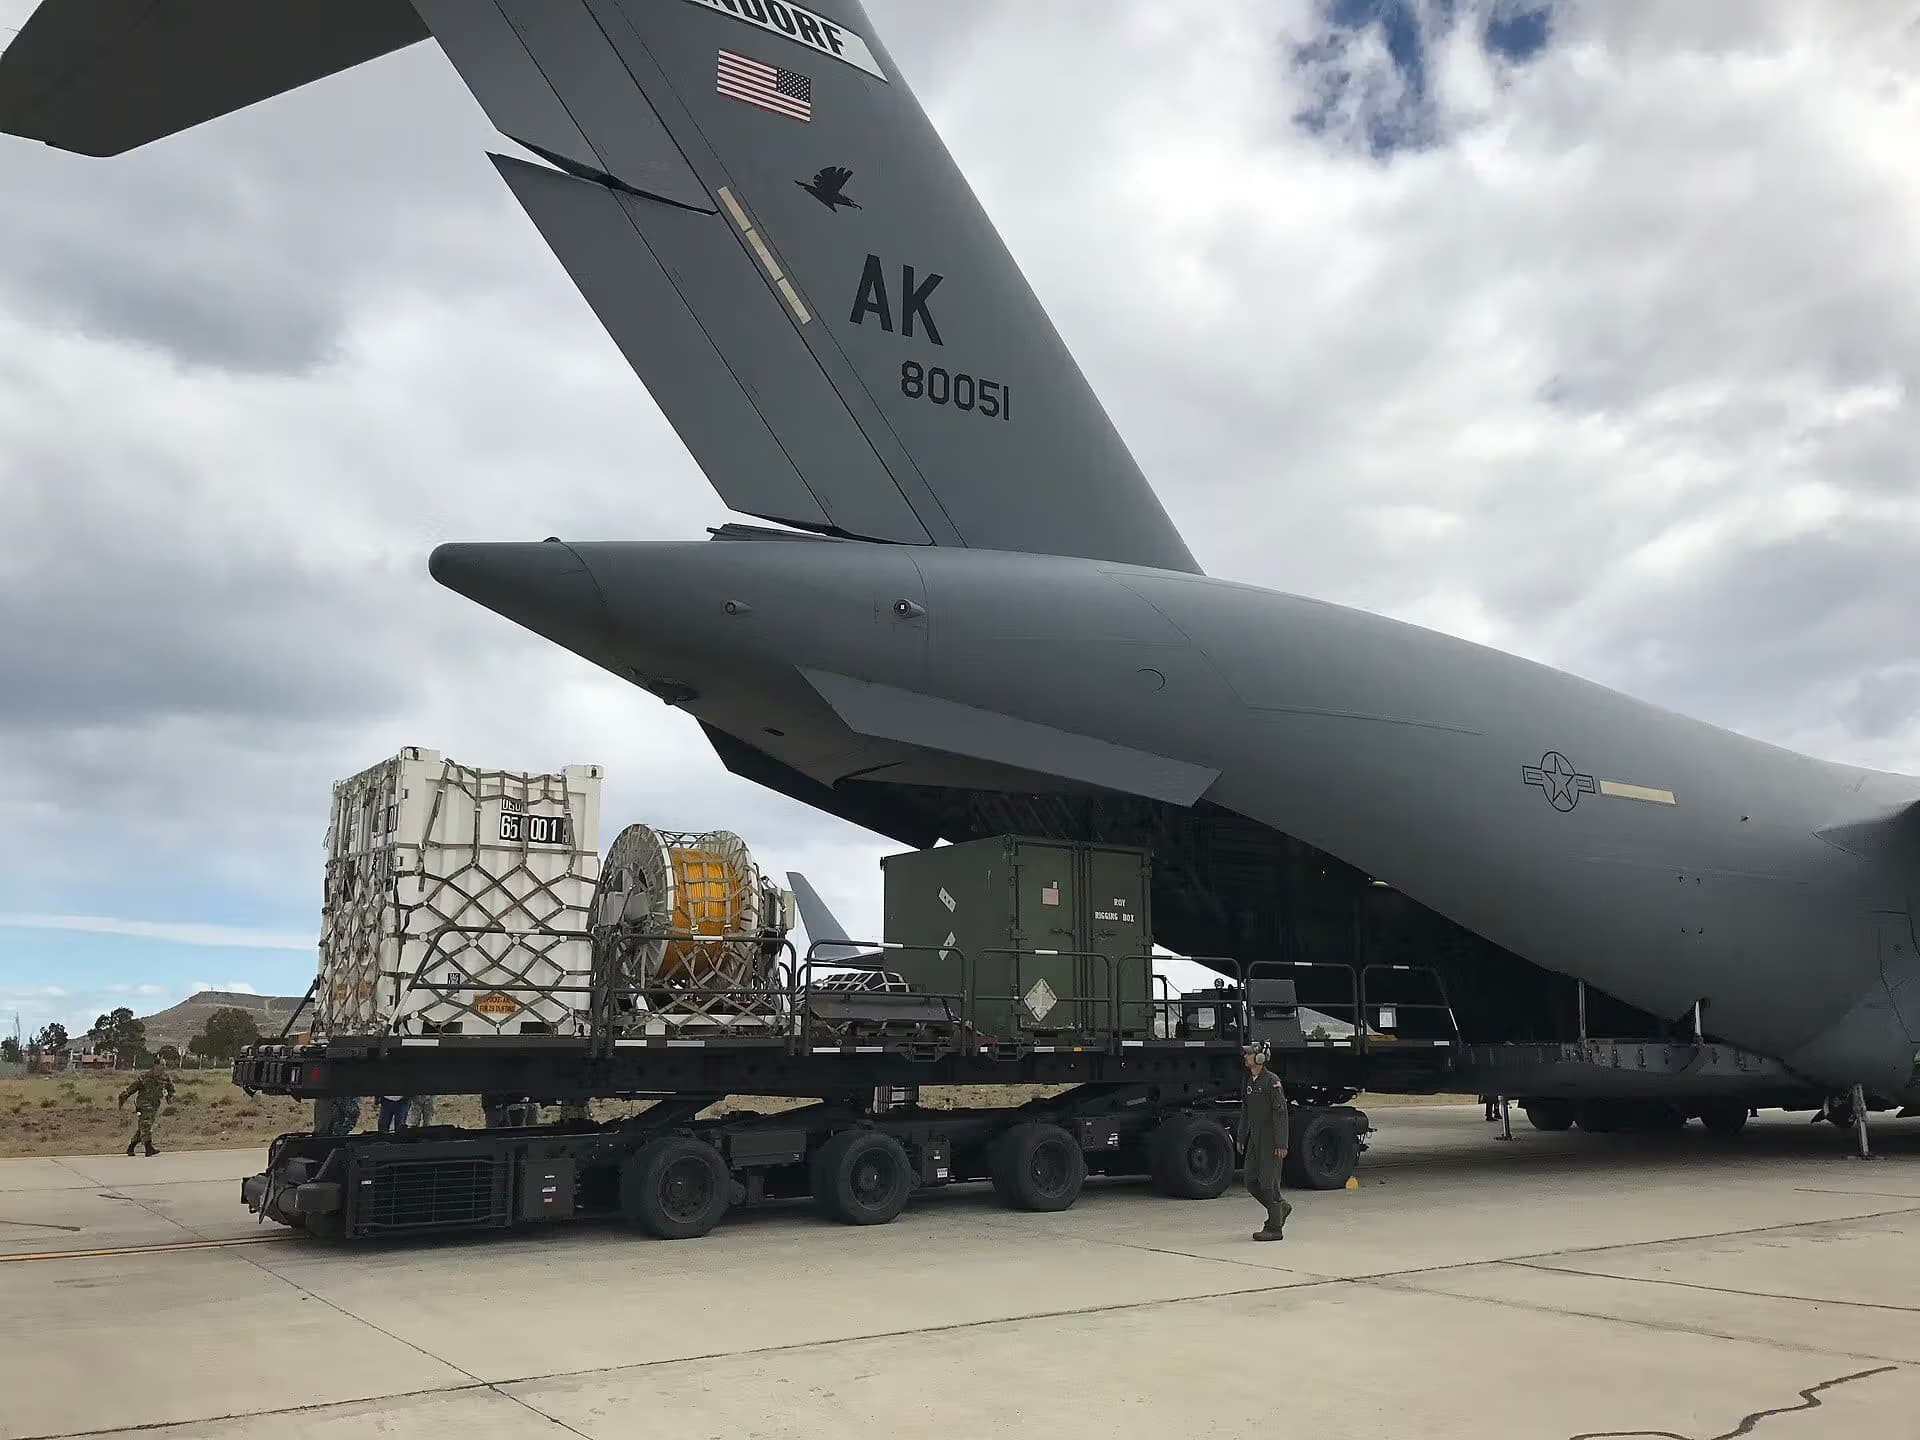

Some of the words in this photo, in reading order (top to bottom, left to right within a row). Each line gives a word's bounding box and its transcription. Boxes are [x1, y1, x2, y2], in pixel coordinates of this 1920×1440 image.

[850, 254, 944, 346] AK
[902, 360, 1010, 421] 80051
[500, 815, 558, 842] 65001
